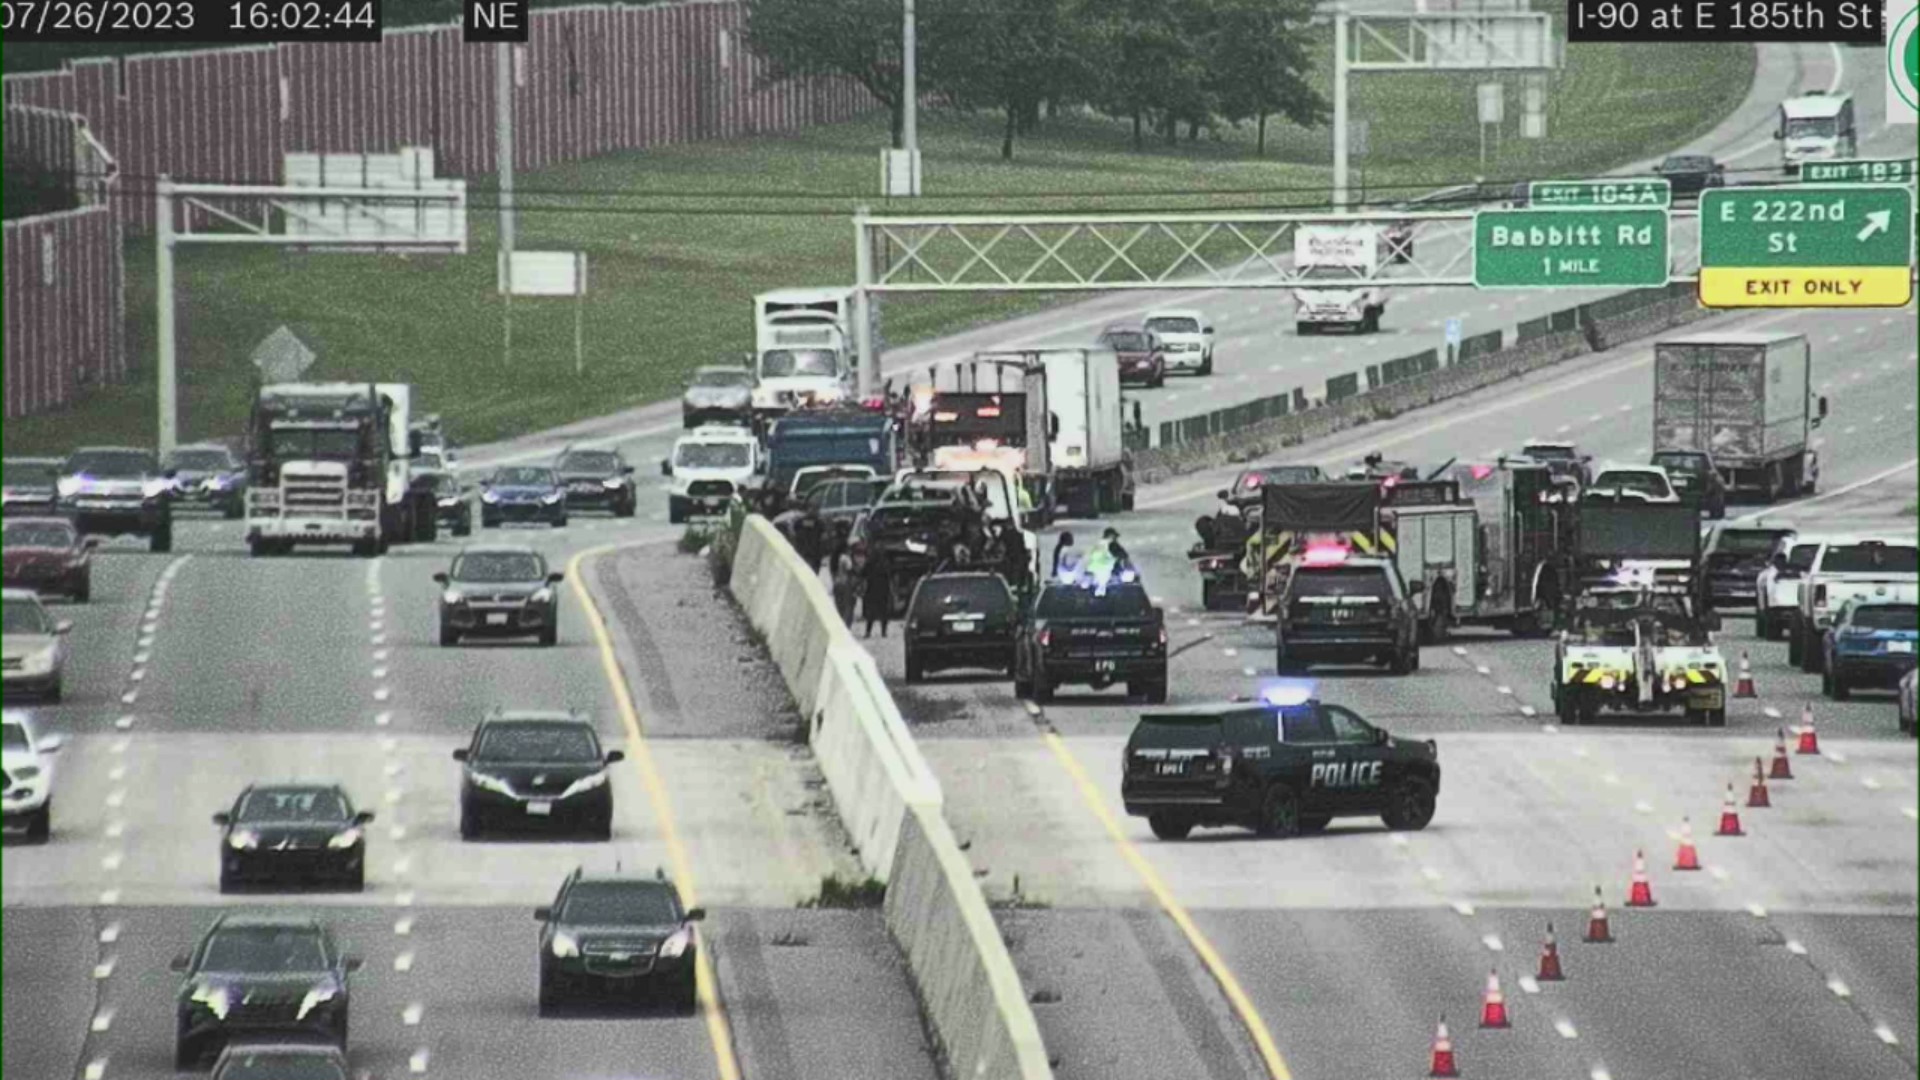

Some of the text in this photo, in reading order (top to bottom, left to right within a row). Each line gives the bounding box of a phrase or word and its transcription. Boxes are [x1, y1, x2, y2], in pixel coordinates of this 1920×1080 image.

[1811, 162, 1903, 182] EXIT 183
[1541, 187, 1580, 202] EXIT
[1720, 199, 1845, 221] E 222nd
[1492, 225, 1652, 246] Babbitt Rd
[1768, 231, 1797, 253] St
[1543, 257, 1599, 276] 1 MILE
[1746, 279, 1863, 295] EXIT ONLY
[1311, 760, 1384, 787] POLICE
